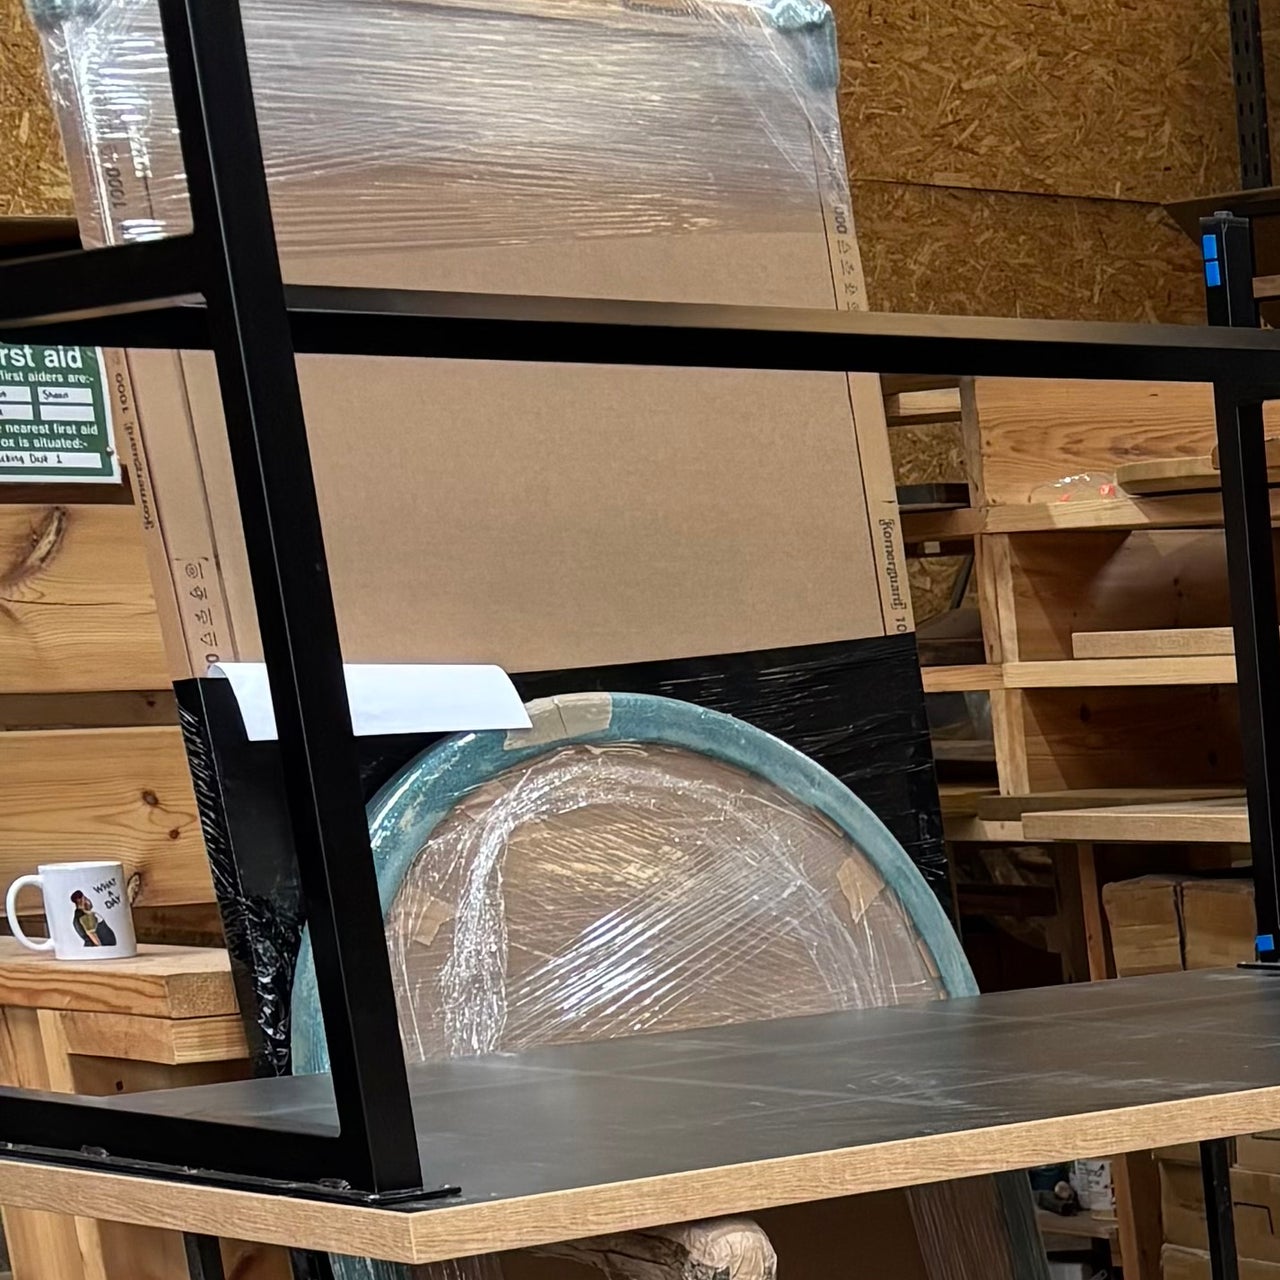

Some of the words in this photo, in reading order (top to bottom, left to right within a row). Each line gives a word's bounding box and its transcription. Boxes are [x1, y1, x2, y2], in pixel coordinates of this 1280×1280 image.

[834, 206, 848, 235] 000
[0, 345, 35, 367] rst
[44, 345, 83, 368] aid
[28, 371, 63, 382] aiders
[115, 372, 128, 413] 1000
[5, 424, 50, 434] nearest
[53, 423, 77, 434] first
[80, 424, 99, 436] aid
[0, 437, 15, 447] ox
[18, 436, 30, 448] is
[896, 616, 908, 632] 10
[104, 894, 121, 909] DAY
